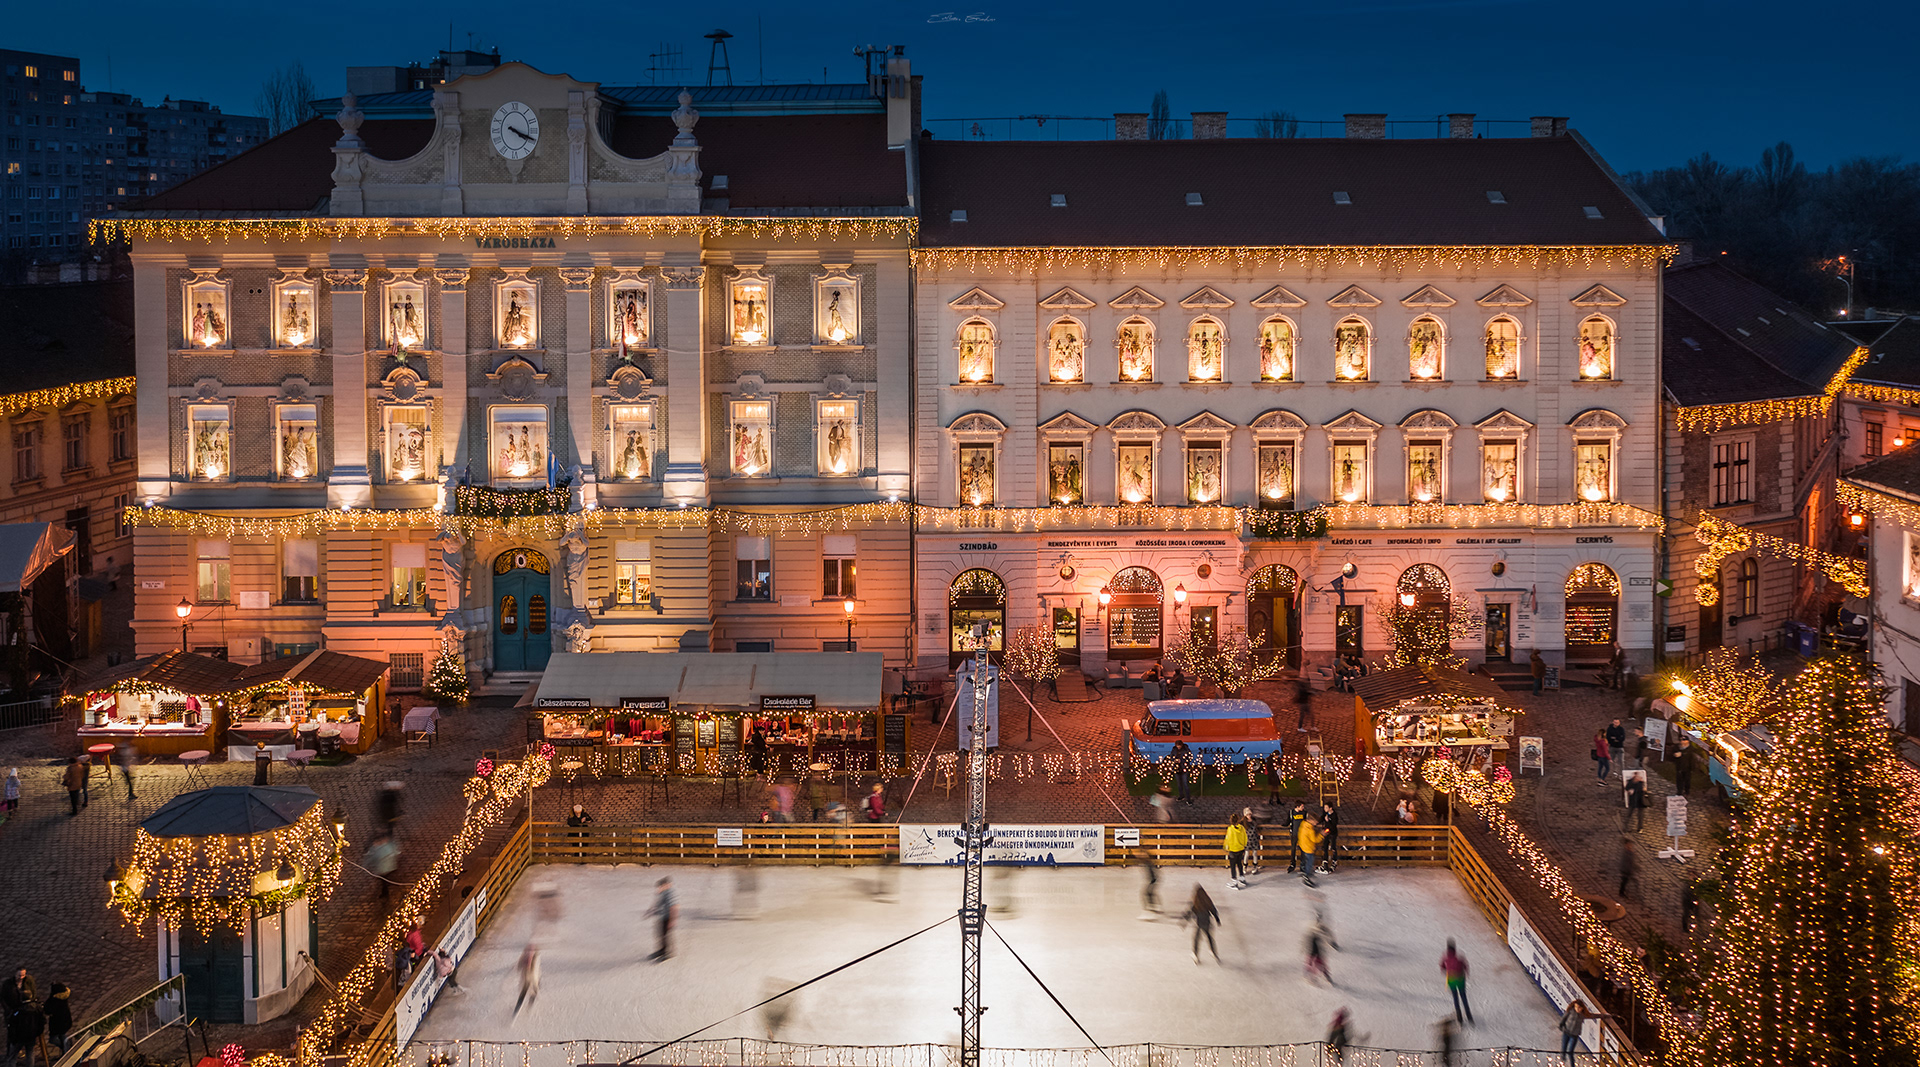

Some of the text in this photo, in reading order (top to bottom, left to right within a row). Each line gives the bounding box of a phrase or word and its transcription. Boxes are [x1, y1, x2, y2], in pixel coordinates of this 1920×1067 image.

[475, 236, 556, 248] VÁROSHÁZA
[959, 542, 998, 550] SZINDBÁD
[937, 829, 955, 838] BÉKÉS
[994, 829, 1026, 838] ÜNNEPEKET
[1027, 829, 1034, 838] ÉS
[1059, 829, 1064, 838] ÚJ
[1066, 829, 1079, 838] ÉVET
[1080, 829, 1098, 838] KÍVÁN
